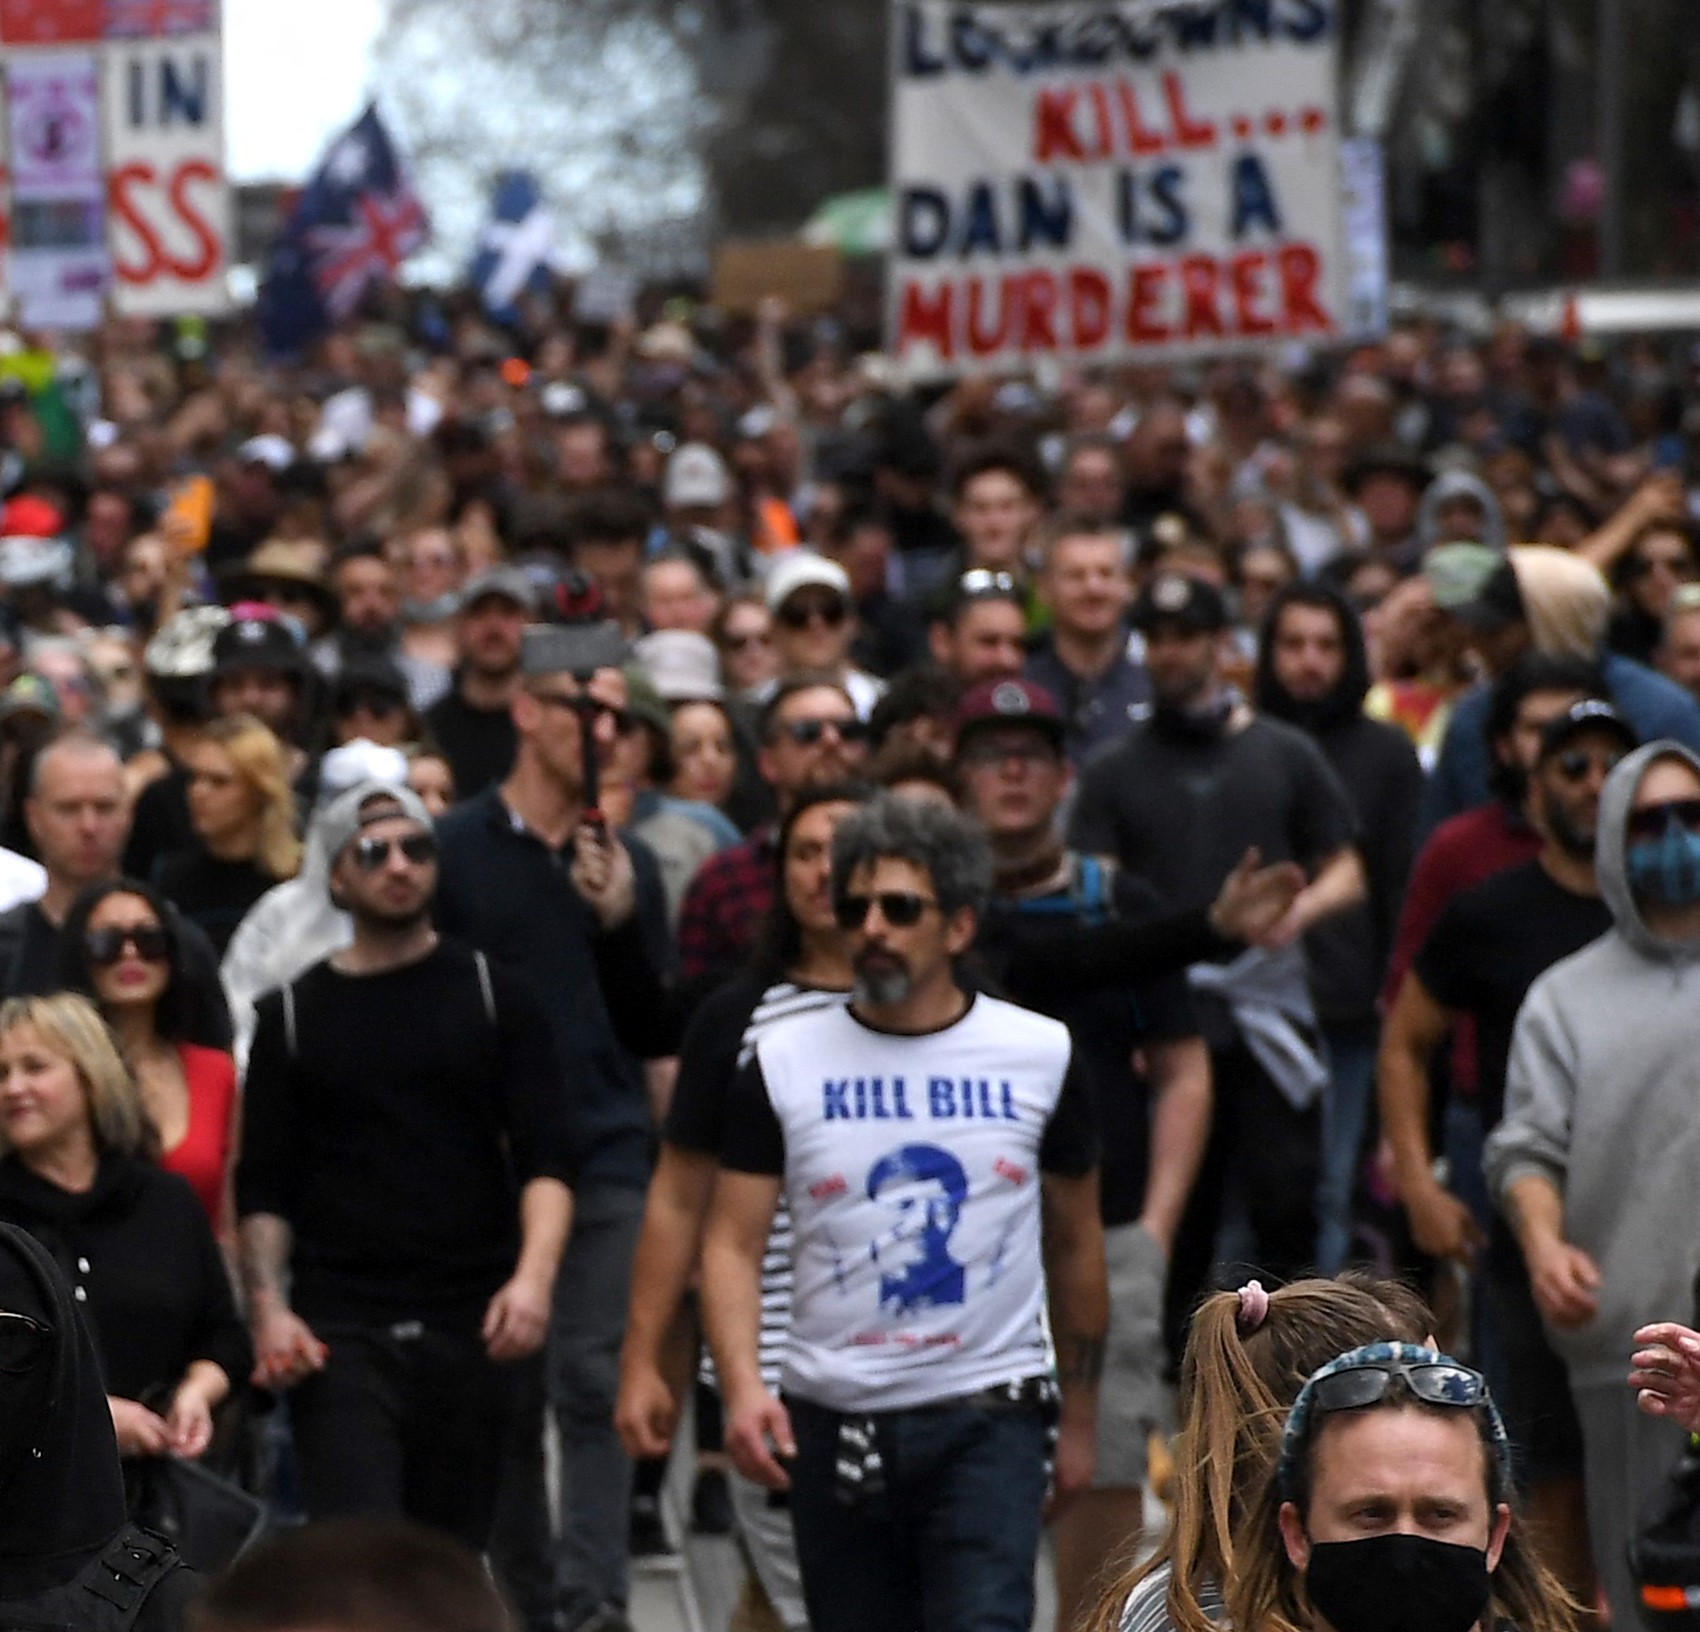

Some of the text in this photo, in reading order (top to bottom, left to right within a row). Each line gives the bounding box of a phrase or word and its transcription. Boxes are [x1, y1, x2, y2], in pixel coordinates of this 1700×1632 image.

[126, 55, 208, 131] IN
[903, 174, 1074, 260] DAN
[1116, 165, 1190, 246] IS
[1231, 150, 1285, 241] A
[900, 243, 1332, 362] MURDERER
[823, 1076, 1022, 1122] KILL BILL
